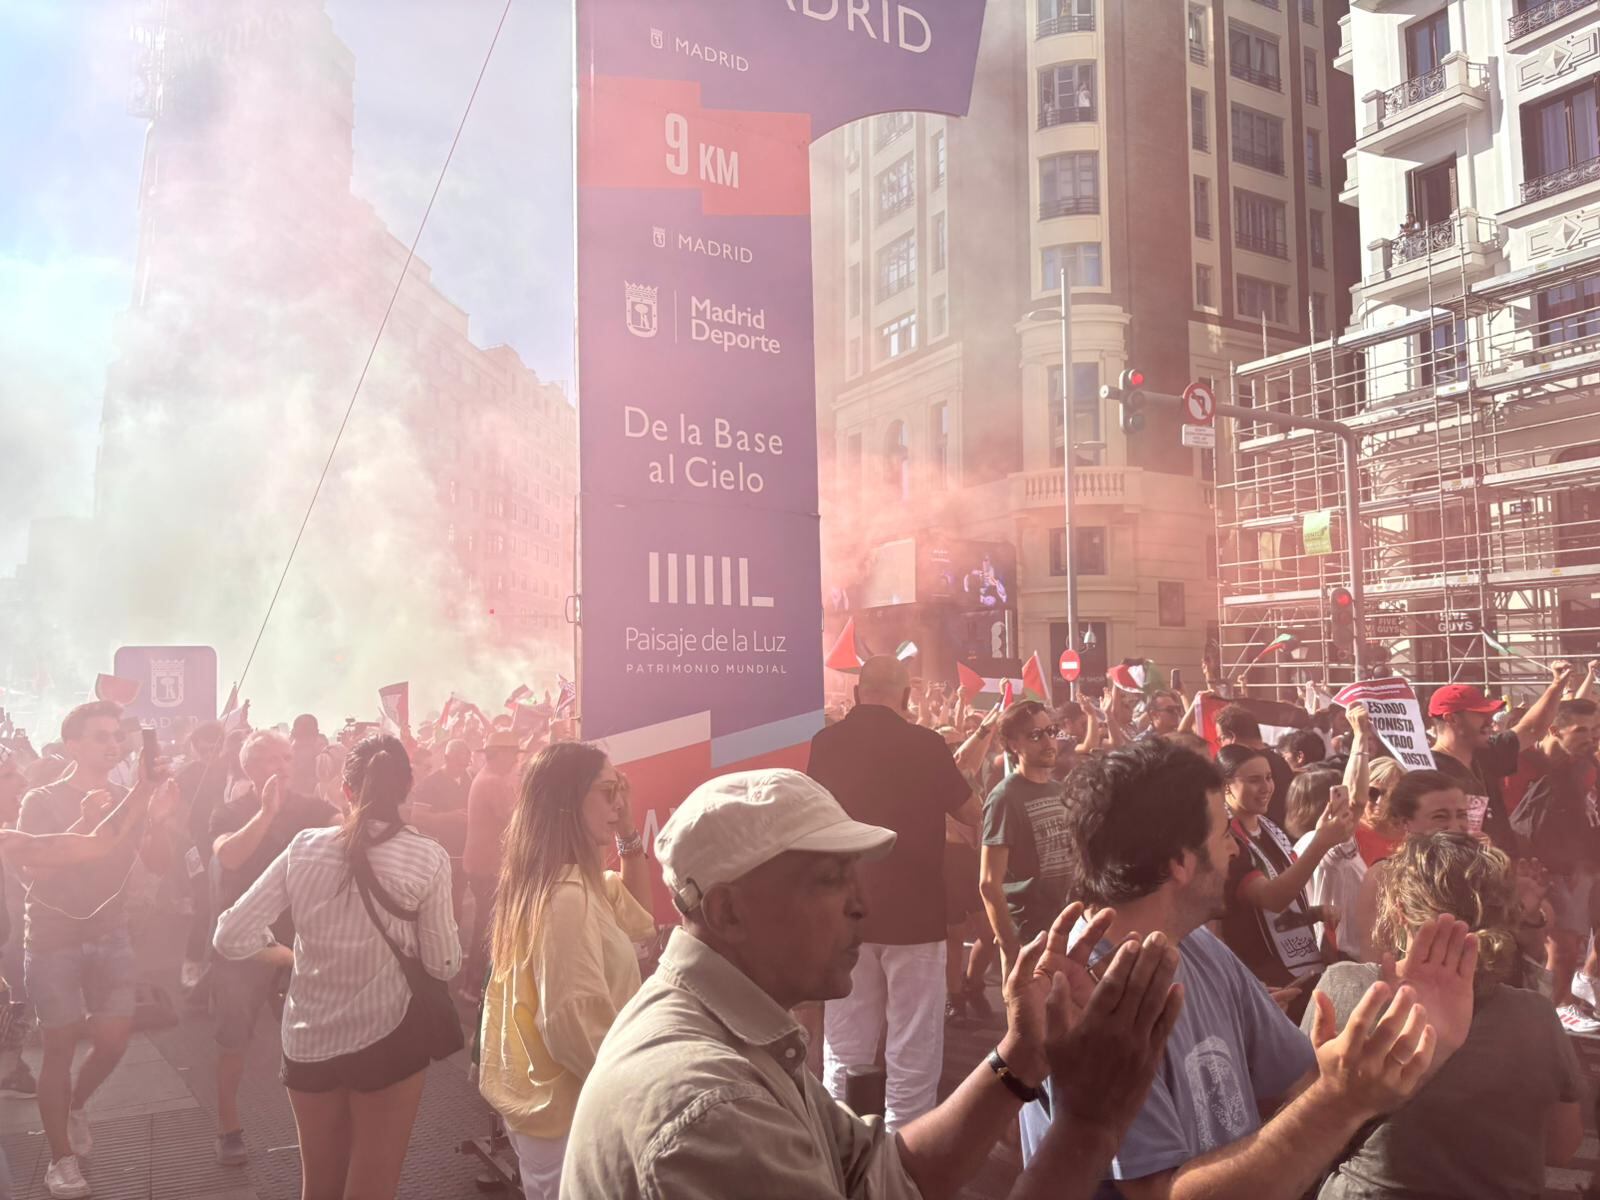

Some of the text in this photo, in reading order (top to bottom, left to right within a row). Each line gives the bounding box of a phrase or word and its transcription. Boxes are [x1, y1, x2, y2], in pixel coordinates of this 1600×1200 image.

[675, 37, 749, 72] MADRID
[664, 113, 739, 189] 9 KM
[678, 233, 753, 263] MADRID
[691, 296, 765, 330] Madrid
[691, 319, 781, 354] Deporte
[624, 405, 783, 455] De la Base
[649, 453, 764, 492] al Cielo
[1438, 621, 1474, 632] GUYS
[625, 627, 787, 657] Paisaje de la Luz
[626, 663, 788, 674] PATRIMONIO MUNDIAL
[1367, 701, 1407, 715] ESTADO
[1368, 717, 1415, 733] IONISTA
[1382, 734, 1414, 750] TADO
